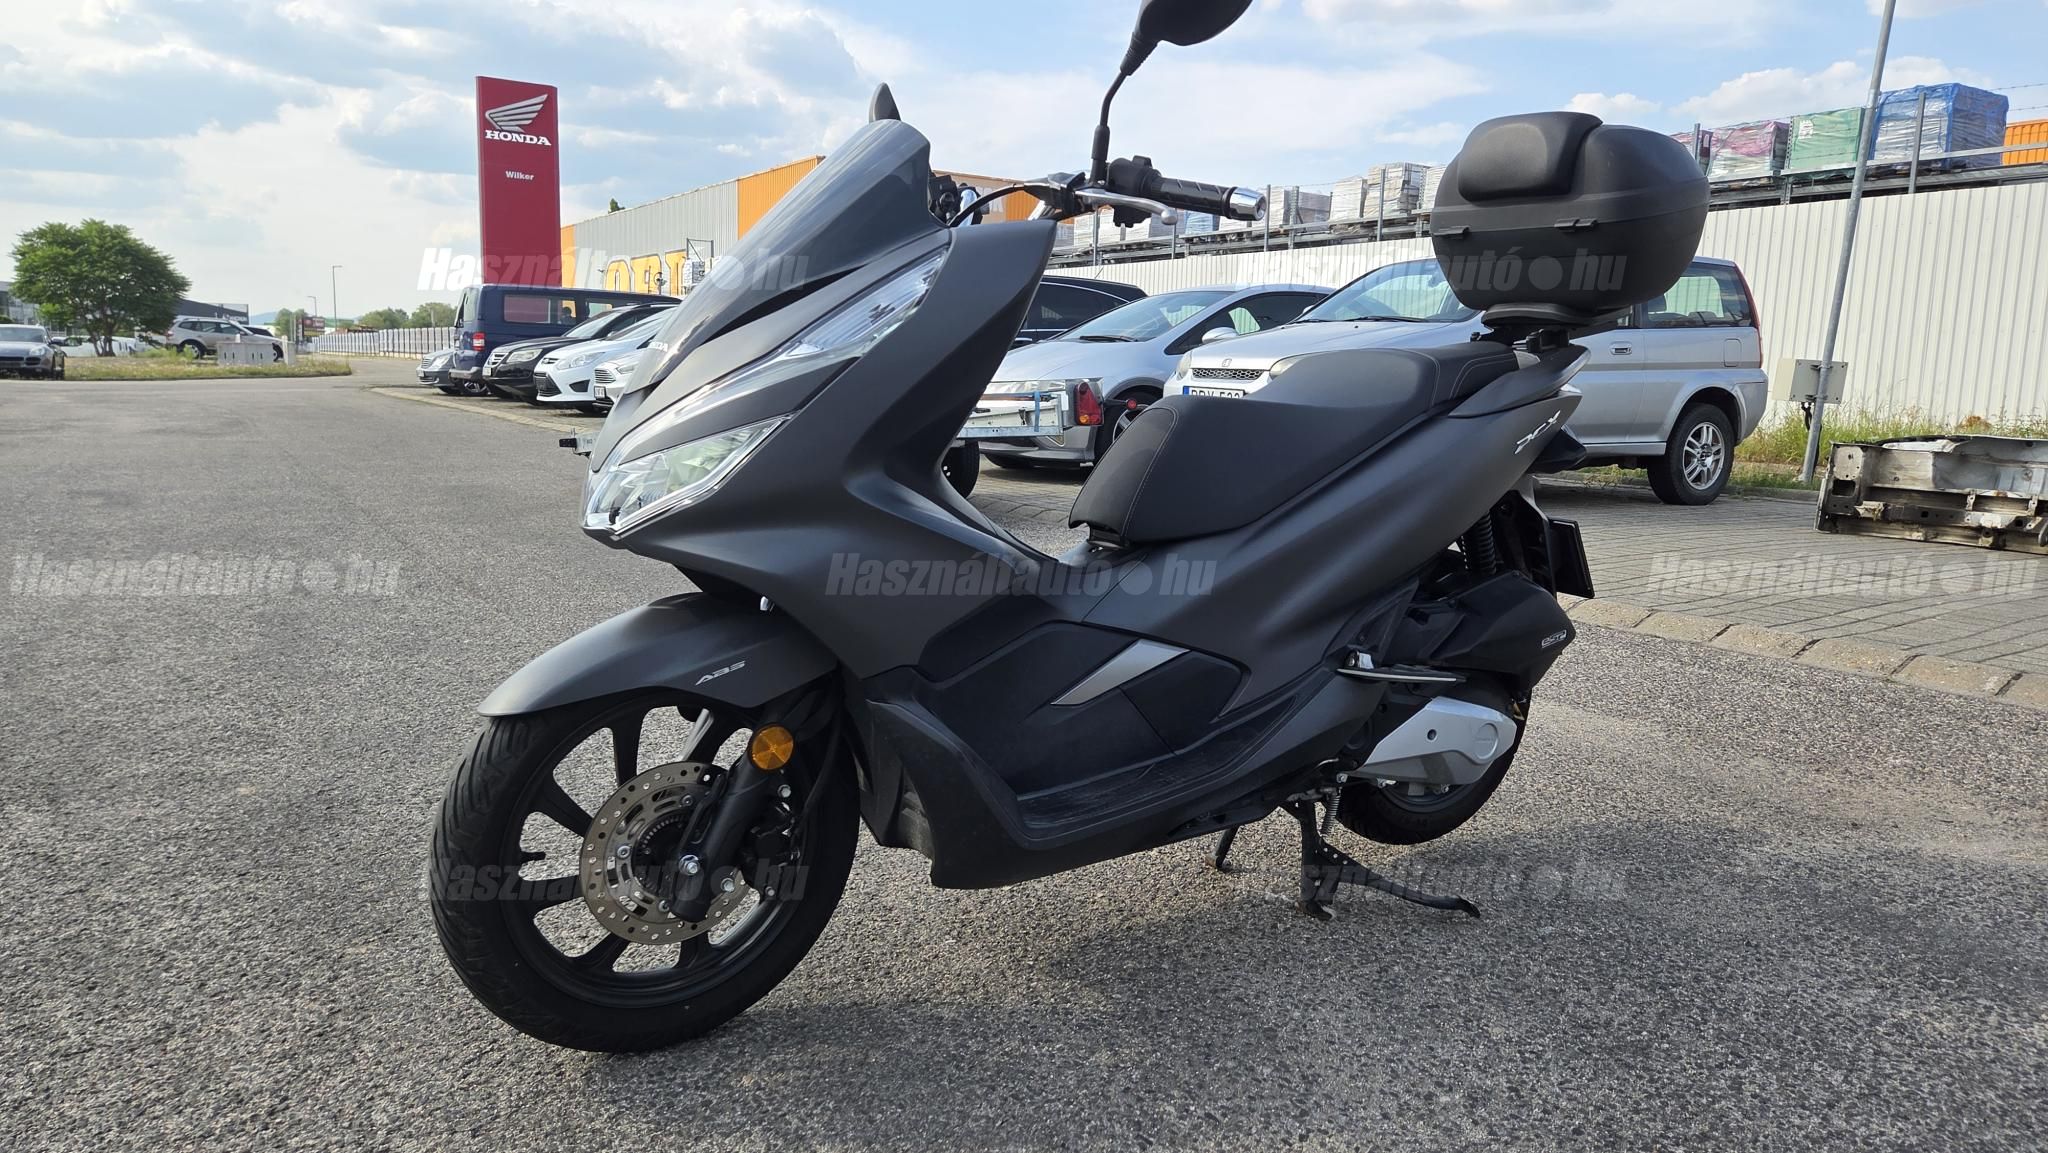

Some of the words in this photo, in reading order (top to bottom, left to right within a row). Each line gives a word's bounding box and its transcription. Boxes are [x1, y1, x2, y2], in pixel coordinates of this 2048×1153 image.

[485, 129, 552, 146] HONDA
[505, 171, 535, 181] Wilker
[695, 660, 746, 686] ABS
